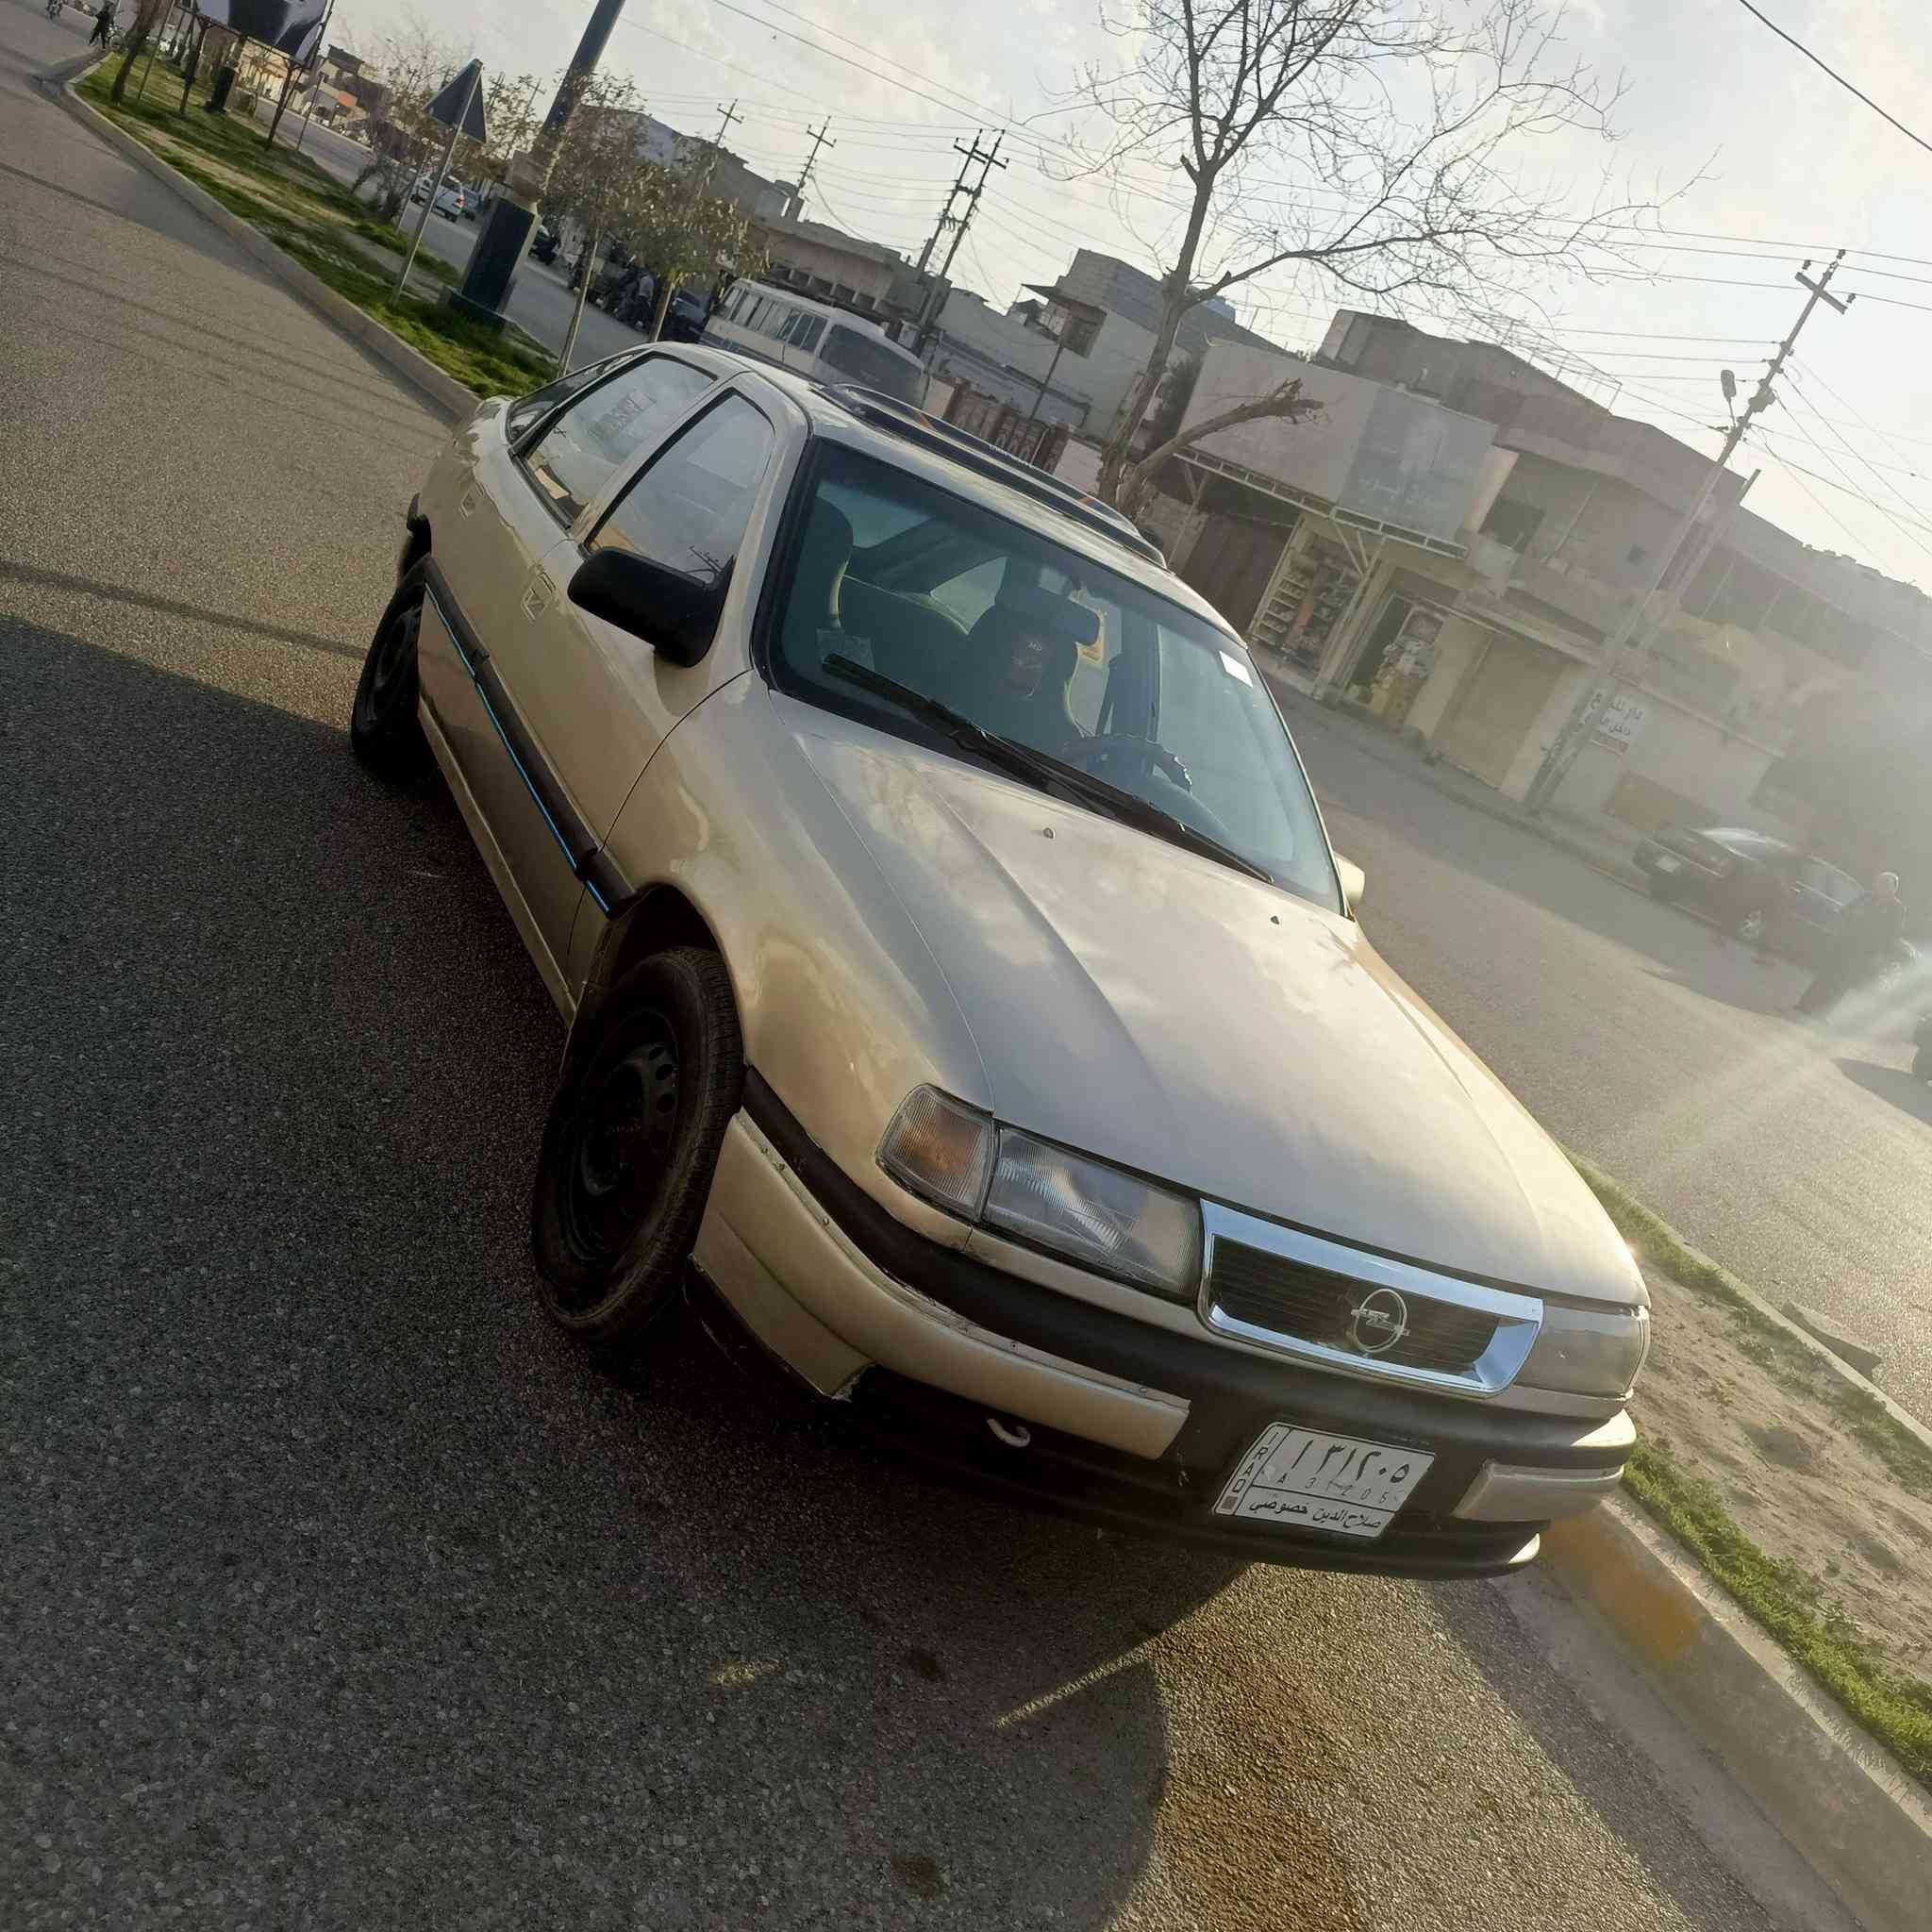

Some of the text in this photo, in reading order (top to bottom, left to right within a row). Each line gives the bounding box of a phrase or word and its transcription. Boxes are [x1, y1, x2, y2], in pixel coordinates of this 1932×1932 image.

[1248, 1500, 1382, 1529] صلاح الدين خصوصي
